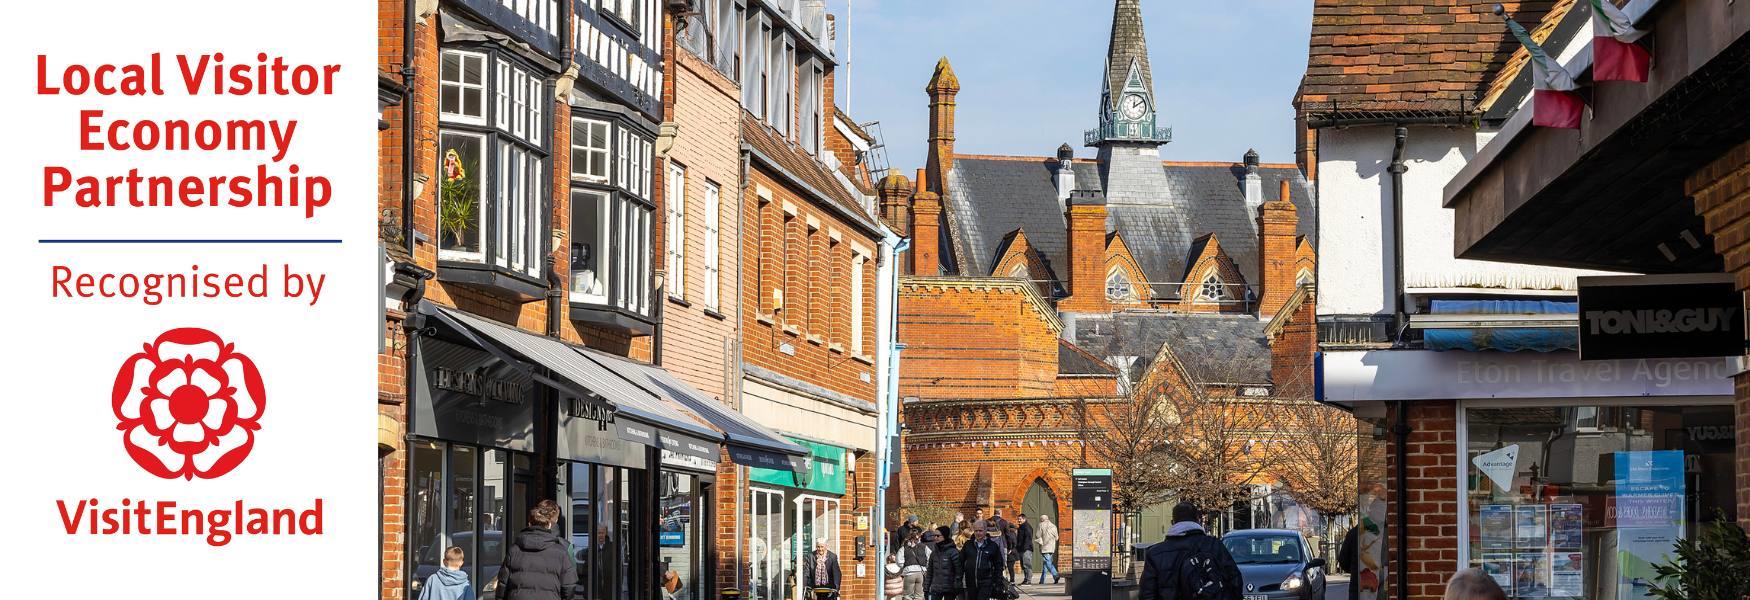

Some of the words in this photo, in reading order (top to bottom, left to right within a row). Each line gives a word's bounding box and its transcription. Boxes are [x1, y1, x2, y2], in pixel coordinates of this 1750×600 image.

[1586, 307, 1737, 335] TONI&GUY
[1457, 360, 1521, 384] Eton
[1532, 359, 1621, 384] Travel
